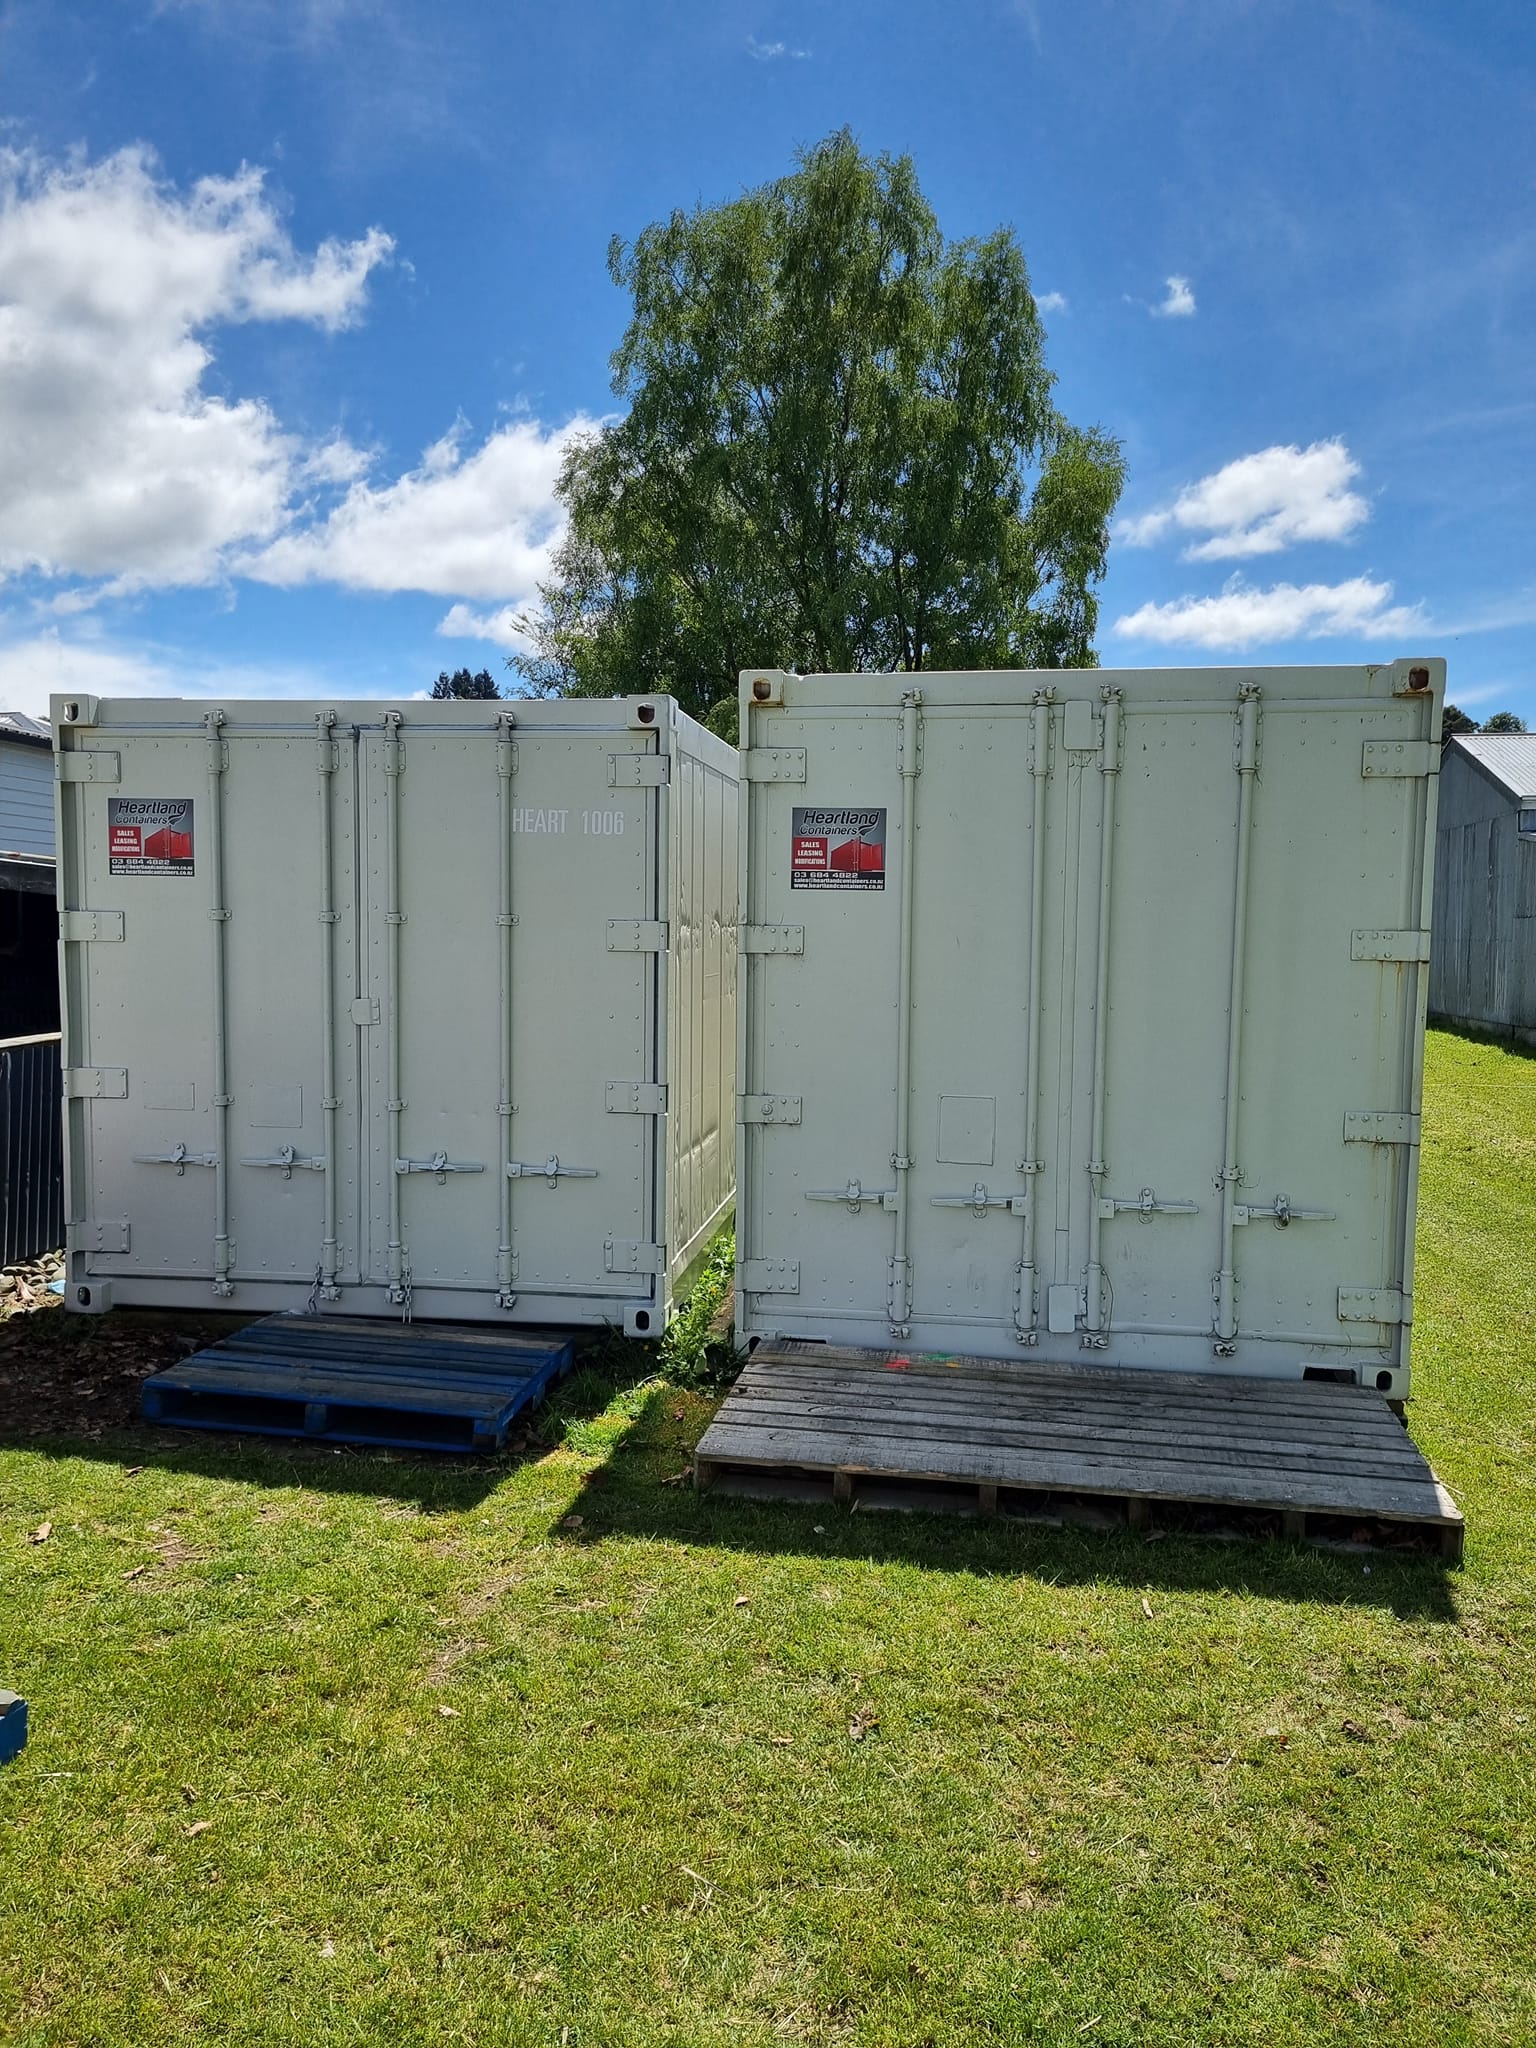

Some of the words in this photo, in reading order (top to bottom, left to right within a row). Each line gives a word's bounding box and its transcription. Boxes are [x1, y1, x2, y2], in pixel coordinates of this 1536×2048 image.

[118, 801, 187, 815] Heartland
[115, 815, 168, 825] Containers
[512, 808, 568, 833] HEART
[582, 810, 625, 835] 1006
[803, 810, 880, 825] Heartland
[800, 824, 858, 835] Containers
[797, 849, 823, 857] LEASING
